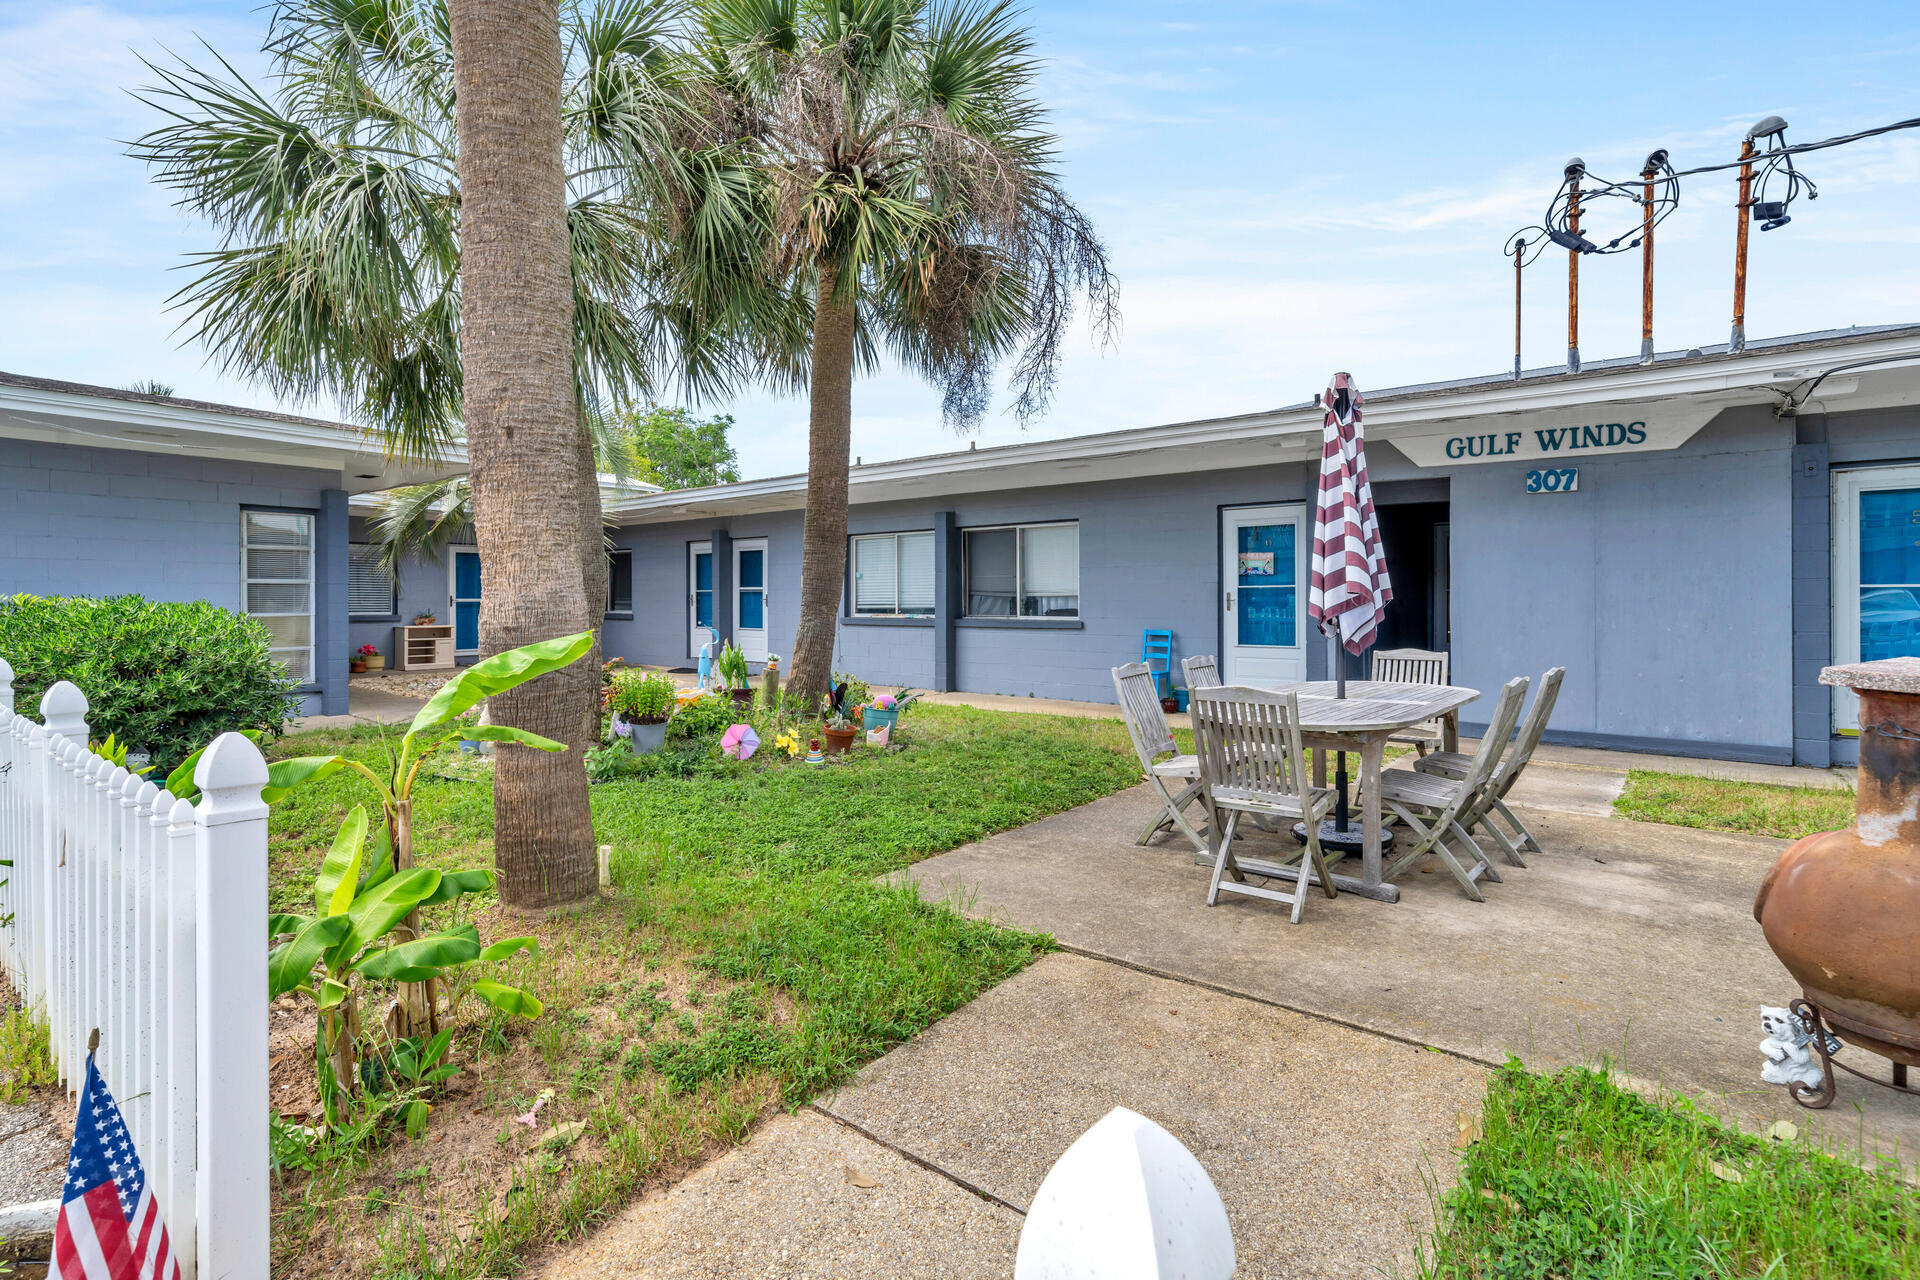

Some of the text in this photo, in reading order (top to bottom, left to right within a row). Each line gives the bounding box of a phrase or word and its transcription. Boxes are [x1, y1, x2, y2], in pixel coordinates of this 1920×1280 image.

[1446, 421, 1647, 459] GULF WINDS
[1527, 469, 1577, 492] 307
